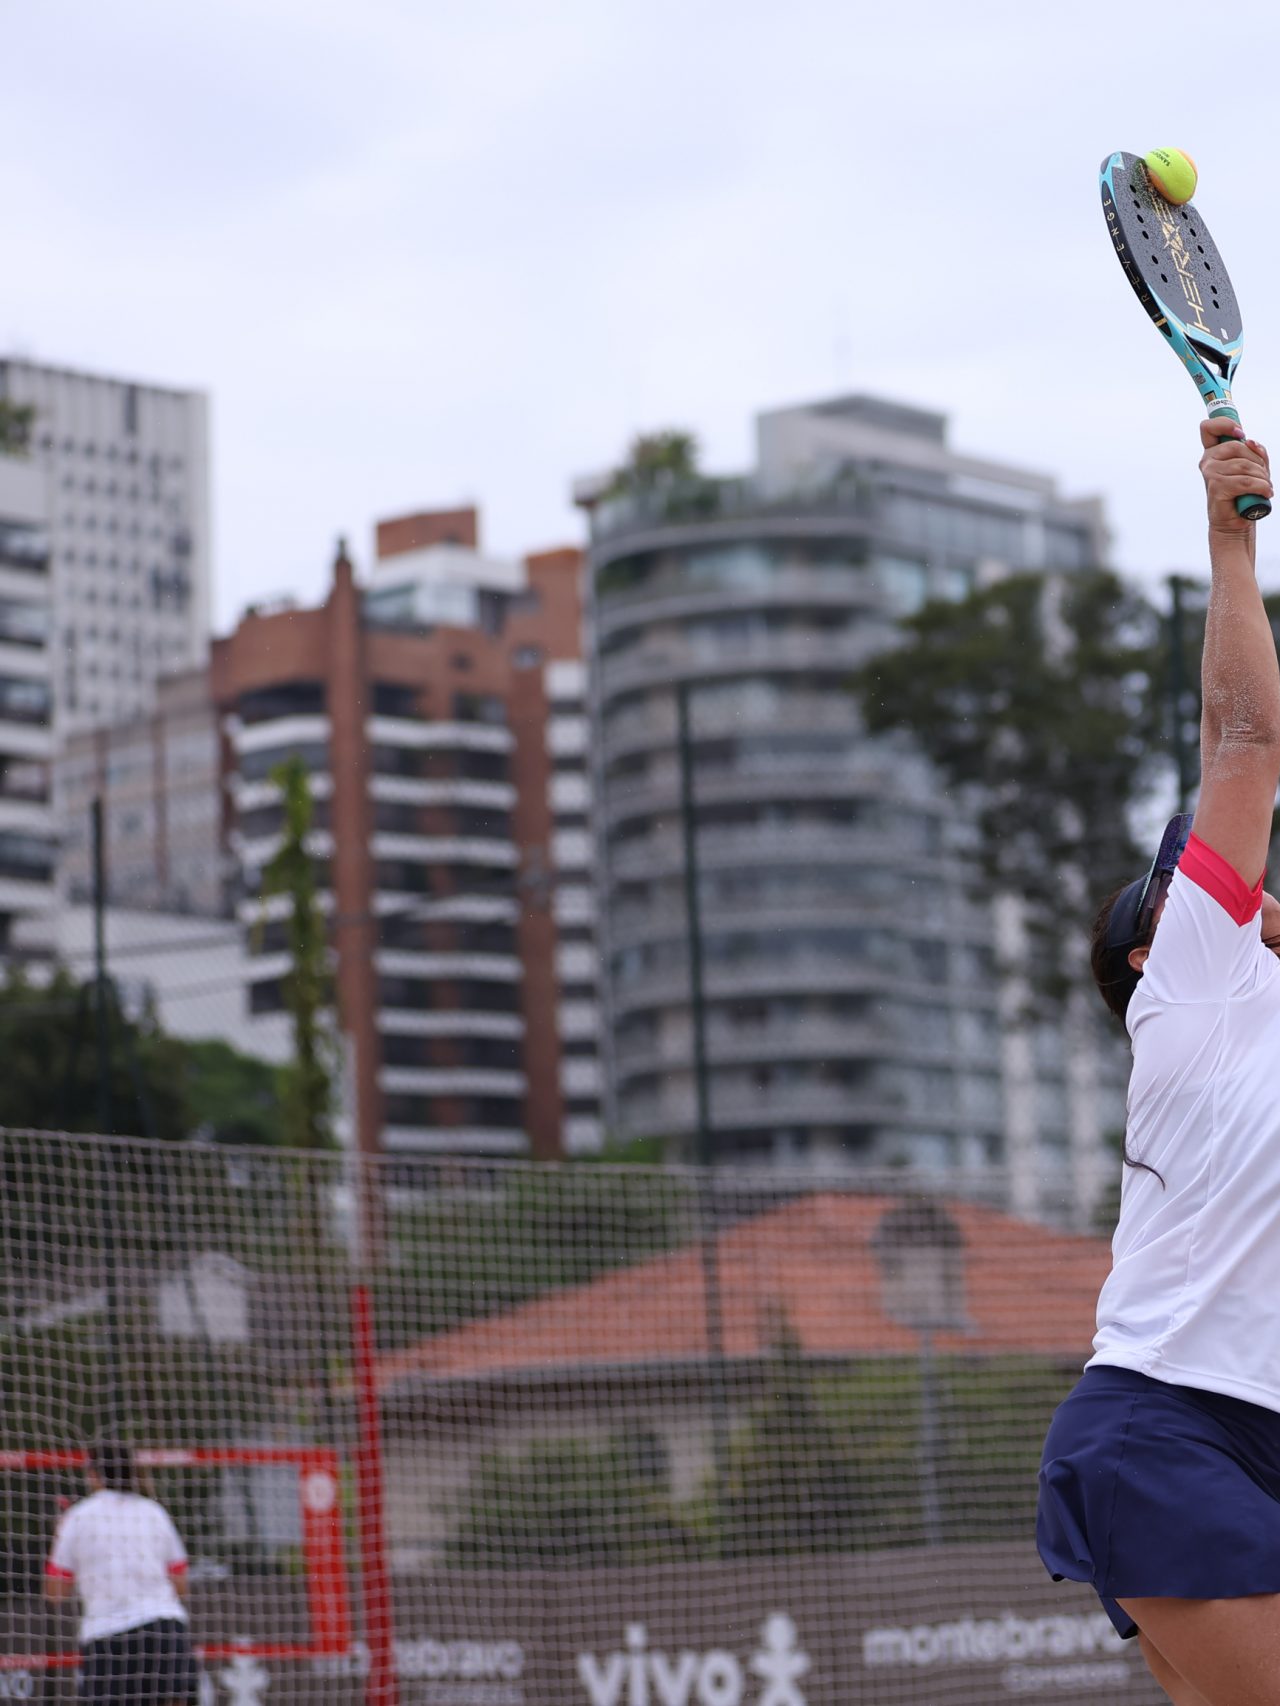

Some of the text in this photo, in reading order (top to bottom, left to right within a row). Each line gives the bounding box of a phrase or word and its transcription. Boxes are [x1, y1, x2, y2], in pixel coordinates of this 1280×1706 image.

[1103, 198, 1151, 303] REVENGE
[577, 1621, 744, 1706] vivo
[863, 1610, 1132, 1668] montebravo
